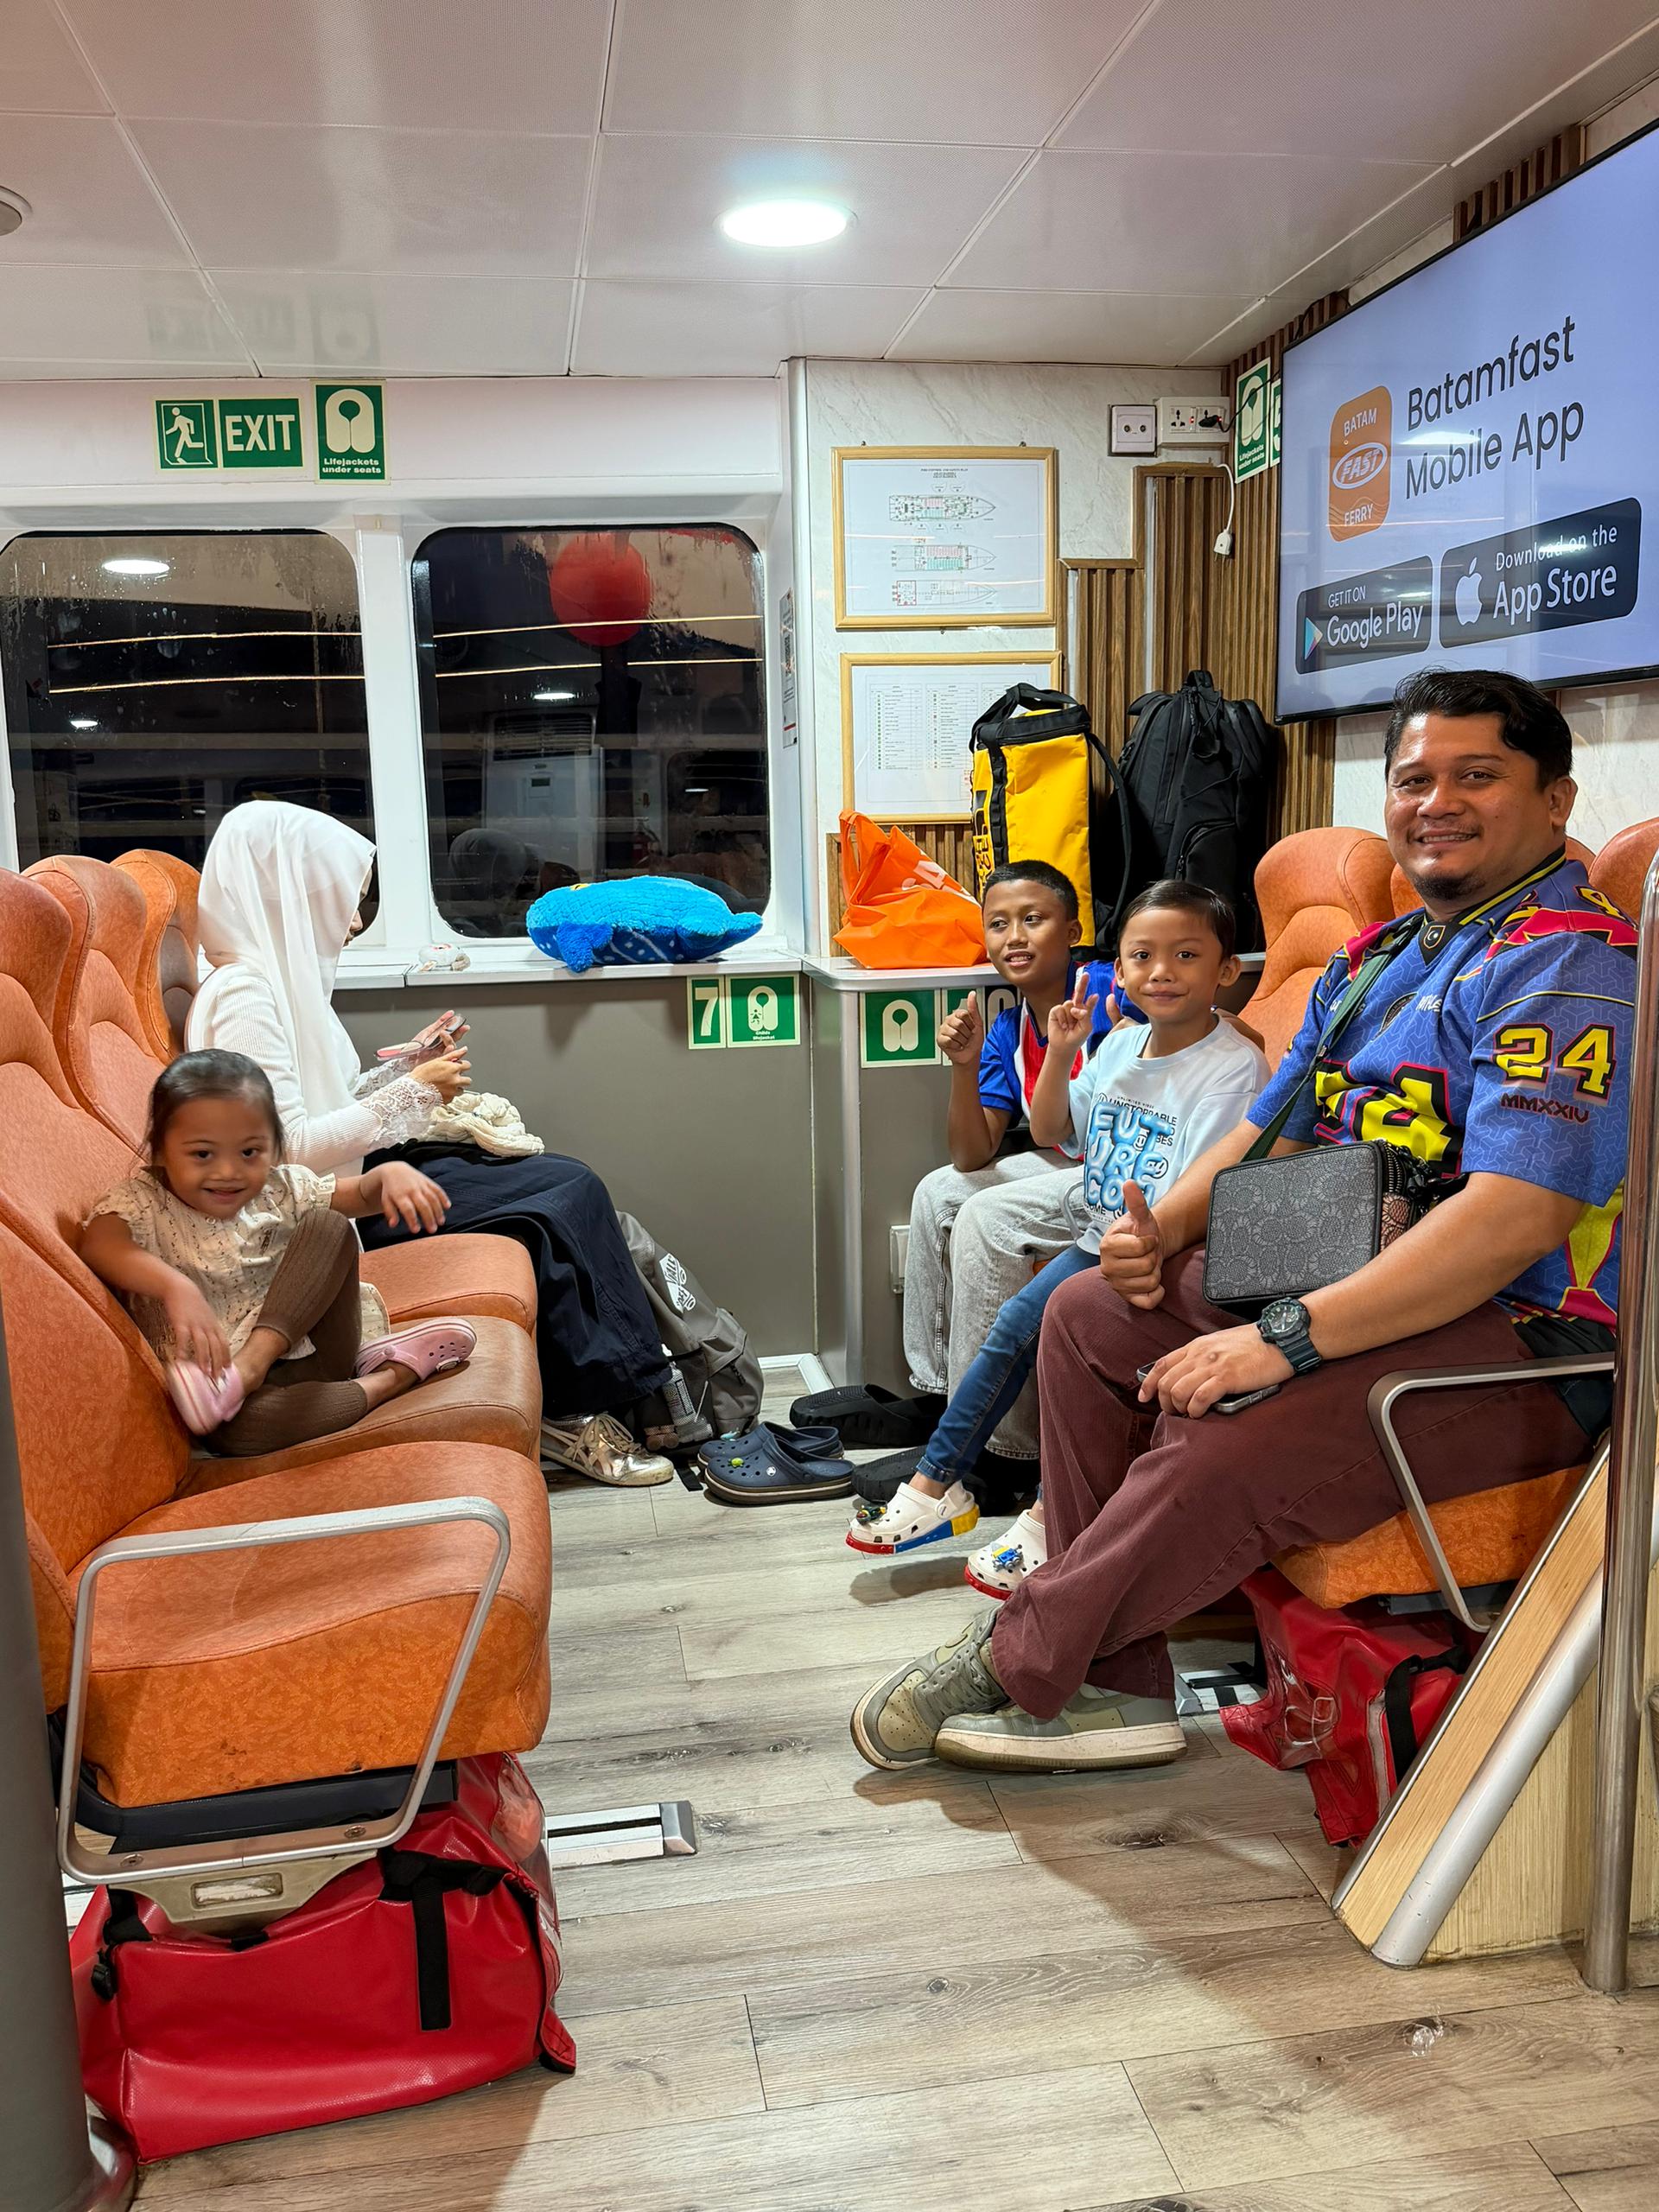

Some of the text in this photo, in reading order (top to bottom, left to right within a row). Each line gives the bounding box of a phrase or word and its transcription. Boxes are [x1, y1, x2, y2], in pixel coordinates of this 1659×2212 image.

[1408, 315, 1575, 431] Batamfast
[225, 415, 296, 452] EXIT
[1344, 407, 1377, 436] BATAM
[323, 458, 379, 467] Lifejackets
[1340, 448, 1382, 484] FAST
[1406, 402, 1584, 499] Mobile App
[1344, 503, 1374, 526] FERRY
[1496, 524, 1618, 571] Download on the
[1328, 585, 1366, 608] GET IT ON
[1493, 565, 1618, 626] App Store
[1327, 601, 1424, 649] Google Play
[695, 987, 719, 1036] 7
[1492, 1022, 1617, 1101] 24
